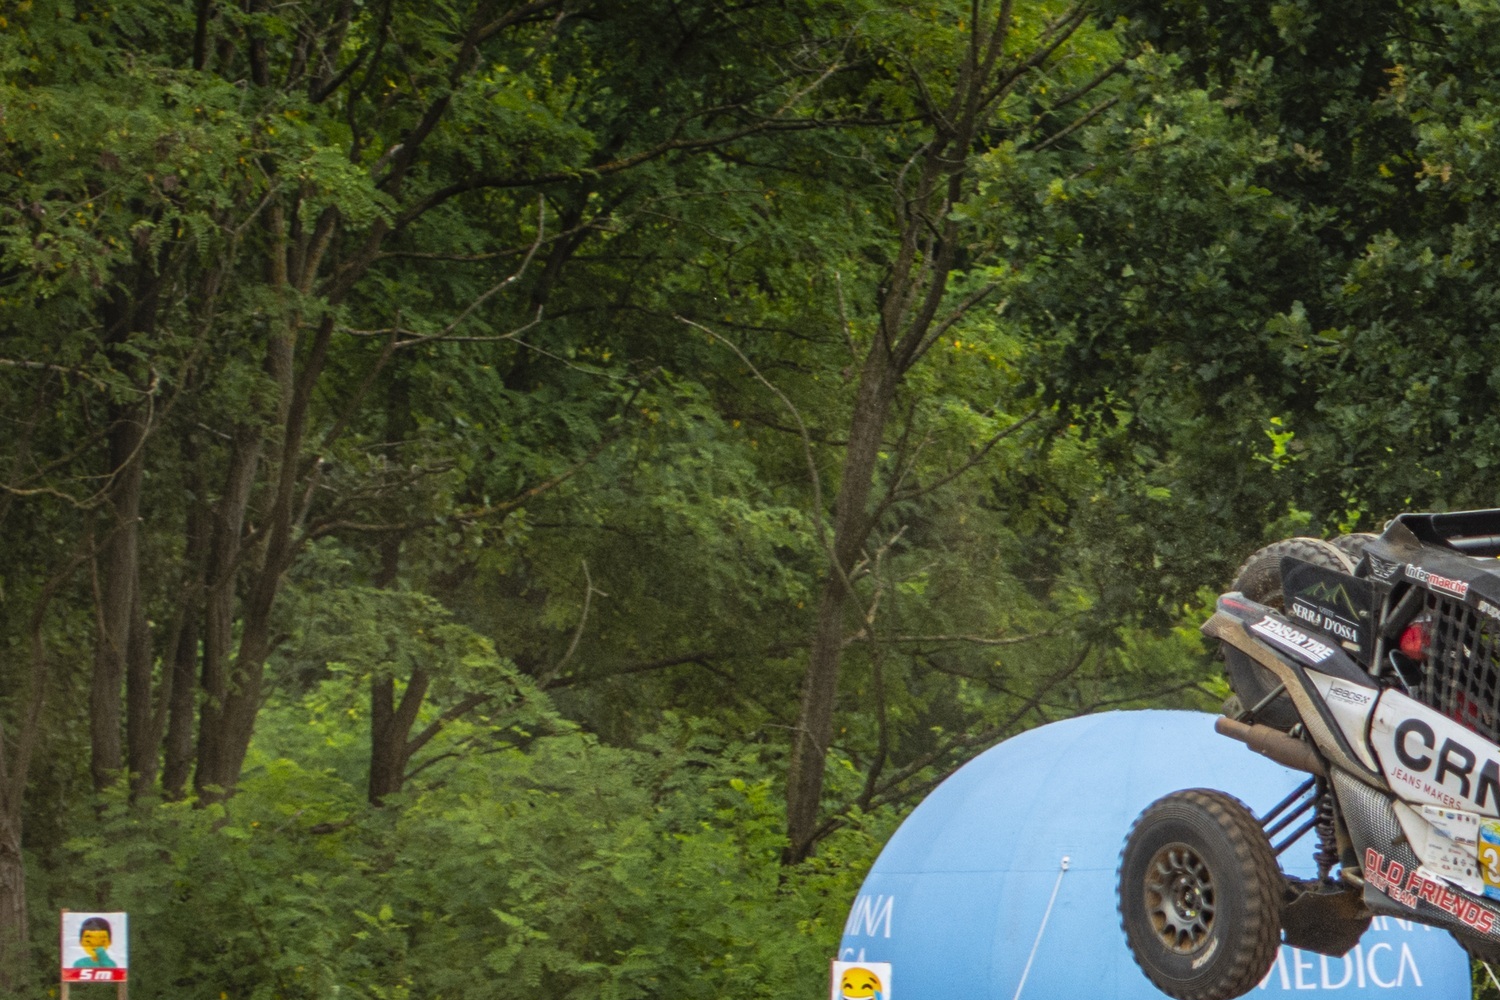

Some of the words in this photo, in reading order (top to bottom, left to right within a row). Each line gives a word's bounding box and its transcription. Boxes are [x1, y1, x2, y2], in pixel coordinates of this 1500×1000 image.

[1292, 602, 1321, 623] SERRA
[1257, 615, 1308, 645] TENSOR
[1302, 637, 1335, 660] TIRE
[1391, 766, 1421, 789] JEANS
[1423, 784, 1462, 809] MAKERS
[1365, 847, 1404, 885] OLD
[1406, 871, 1495, 933] FRIENDS
[1388, 885, 1419, 909] TEAM
[94, 970, 113, 980] m
